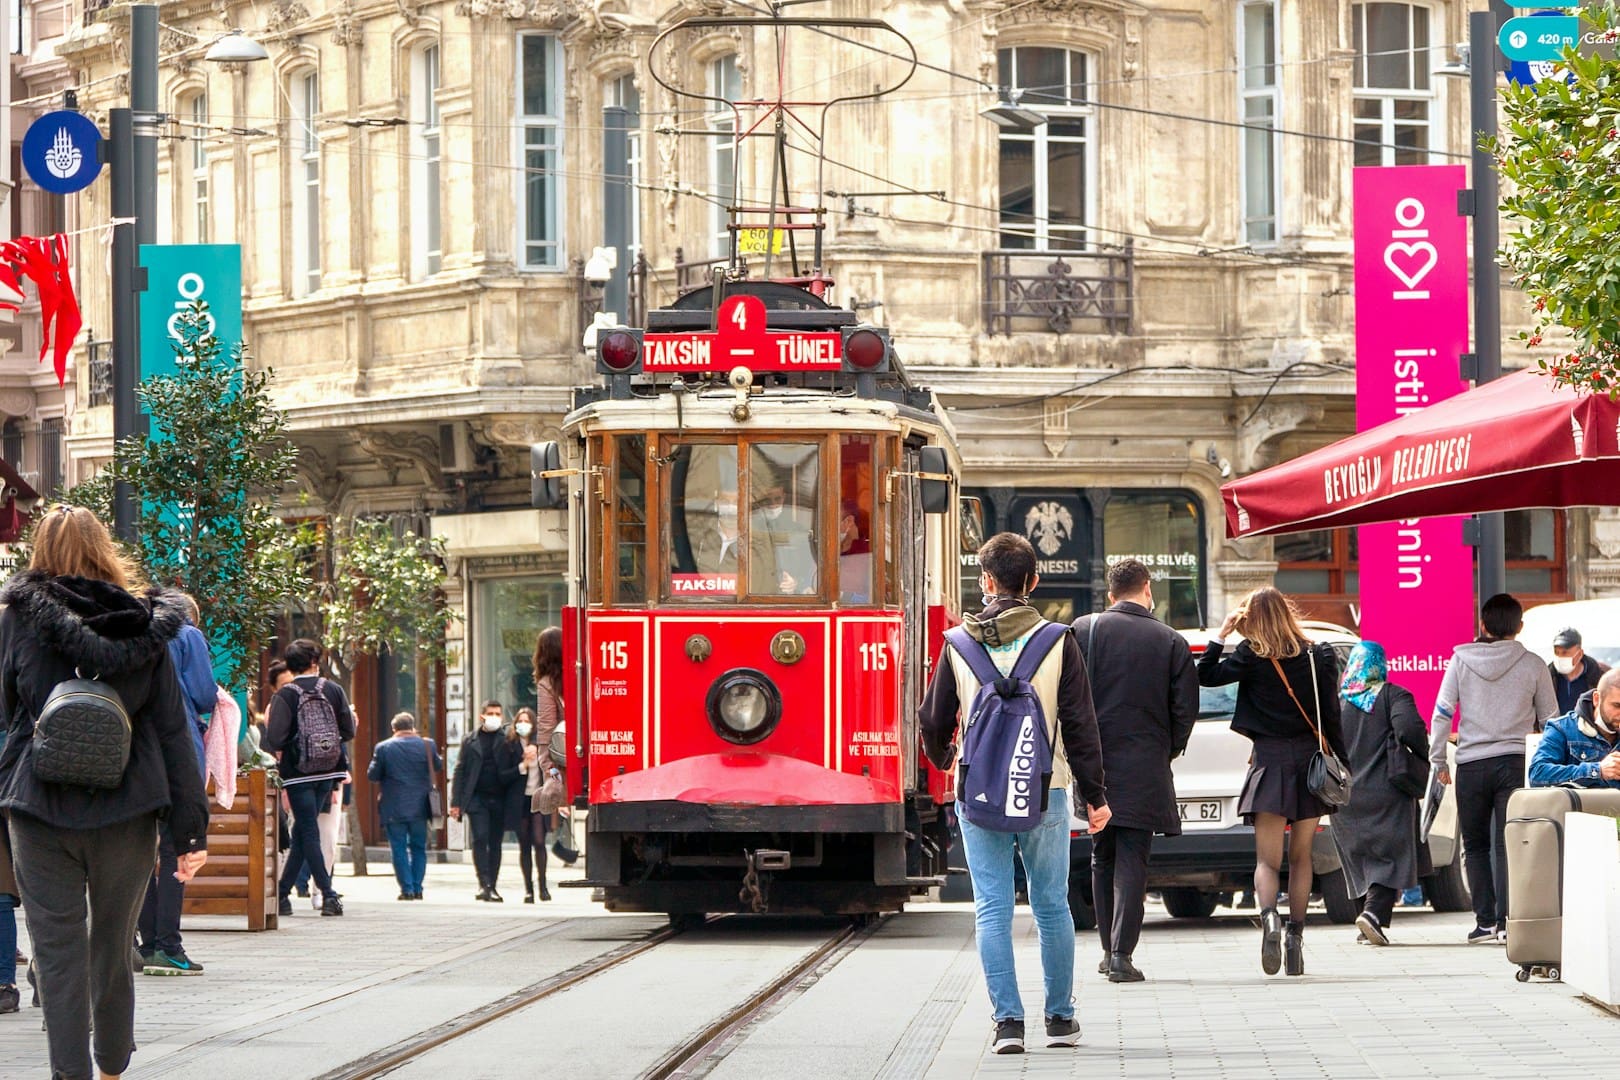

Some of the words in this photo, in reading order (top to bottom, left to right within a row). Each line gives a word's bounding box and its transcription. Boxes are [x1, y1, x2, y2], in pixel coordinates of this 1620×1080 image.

[1537, 33, 1560, 45] 420
[1562, 36, 1573, 44] m
[750, 229, 774, 240] 60
[746, 241, 775, 252] VOL
[731, 301, 747, 331] 4
[643, 335, 711, 366] TAKSİM
[776, 334, 842, 365] TÜNEL
[1324, 455, 1382, 505] BEYOĞLU
[1391, 432, 1472, 486] BELEDİYESİ
[1397, 518, 1431, 589] nin
[1034, 559, 1078, 574] NESIS
[672, 576, 736, 591] TAKSİM
[1150, 569, 1170, 582] oğlu
[600, 641, 628, 670] 115
[859, 642, 888, 671] 115
[1386, 654, 1450, 672] stiklal.is
[600, 687, 614, 696] ALO
[614, 687, 628, 696] 153
[610, 730, 634, 743] YASAK
[849, 744, 861, 757] VE
[1010, 727, 1035, 811] adidas
[1176, 803, 1188, 820] K
[1200, 803, 1218, 819] 62
